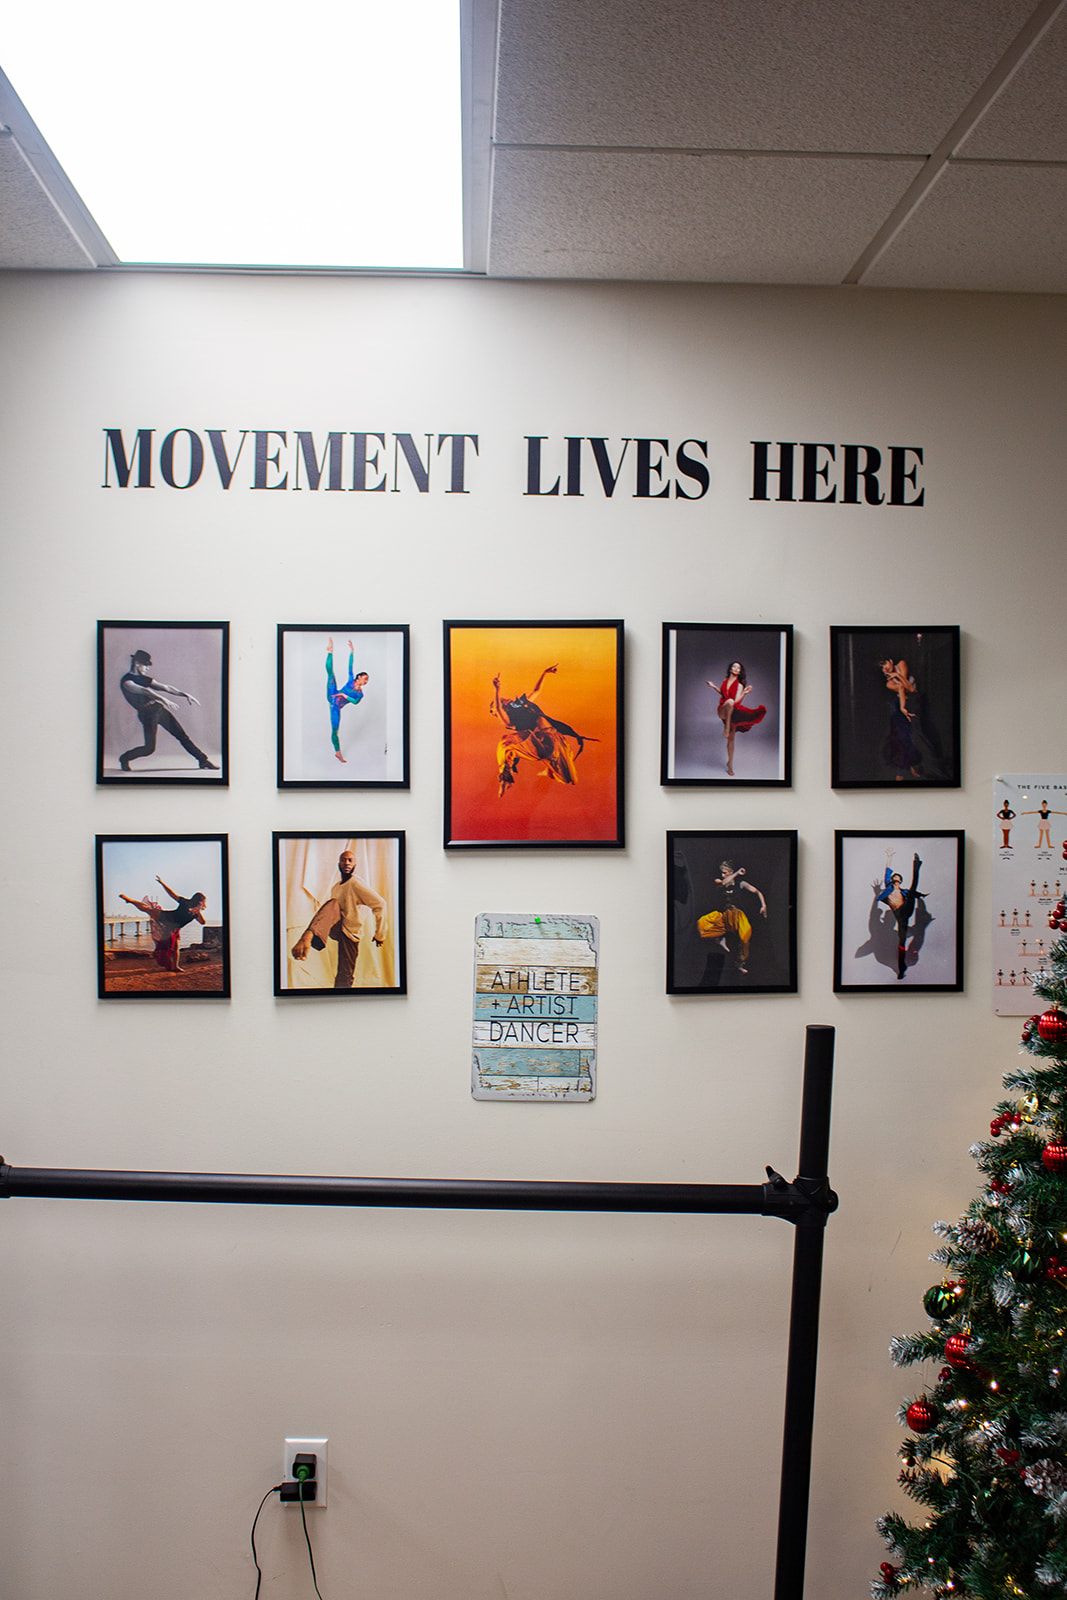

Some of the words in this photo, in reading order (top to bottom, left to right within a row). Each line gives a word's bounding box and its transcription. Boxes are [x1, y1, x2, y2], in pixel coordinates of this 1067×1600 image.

[101, 428, 480, 493] MOVEMENT
[523, 436, 710, 500] LIVES
[749, 441, 925, 507] HERE
[491, 971, 580, 992] ATHLETE
[507, 995, 578, 1015] ARTIST
[489, 1021, 579, 1043] DANCER
